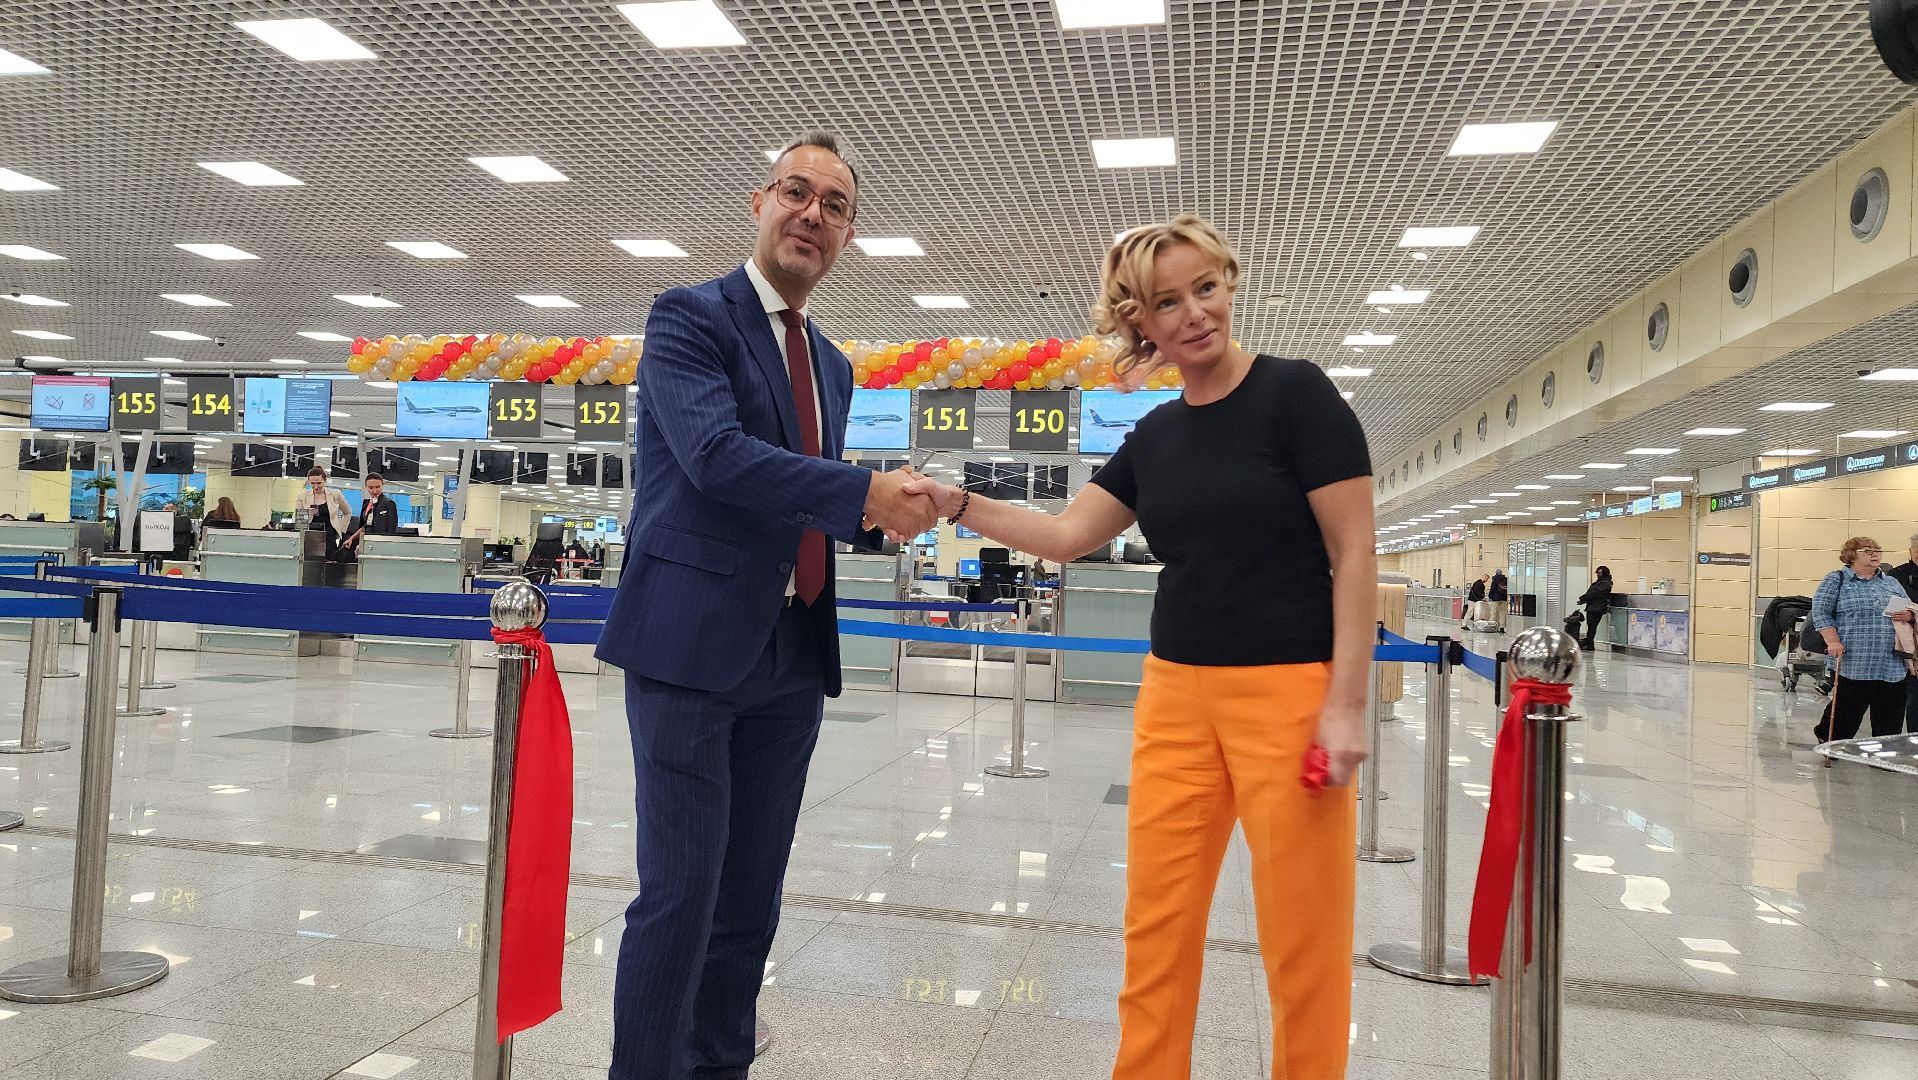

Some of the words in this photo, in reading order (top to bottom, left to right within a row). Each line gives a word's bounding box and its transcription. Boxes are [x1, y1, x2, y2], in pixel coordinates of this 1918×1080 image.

[117, 391, 156, 414] 155
[191, 393, 231, 415] 154
[495, 398, 537, 421] 153
[579, 401, 620, 424] 152
[922, 407, 969, 431] 151
[1015, 408, 1065, 433] 150
